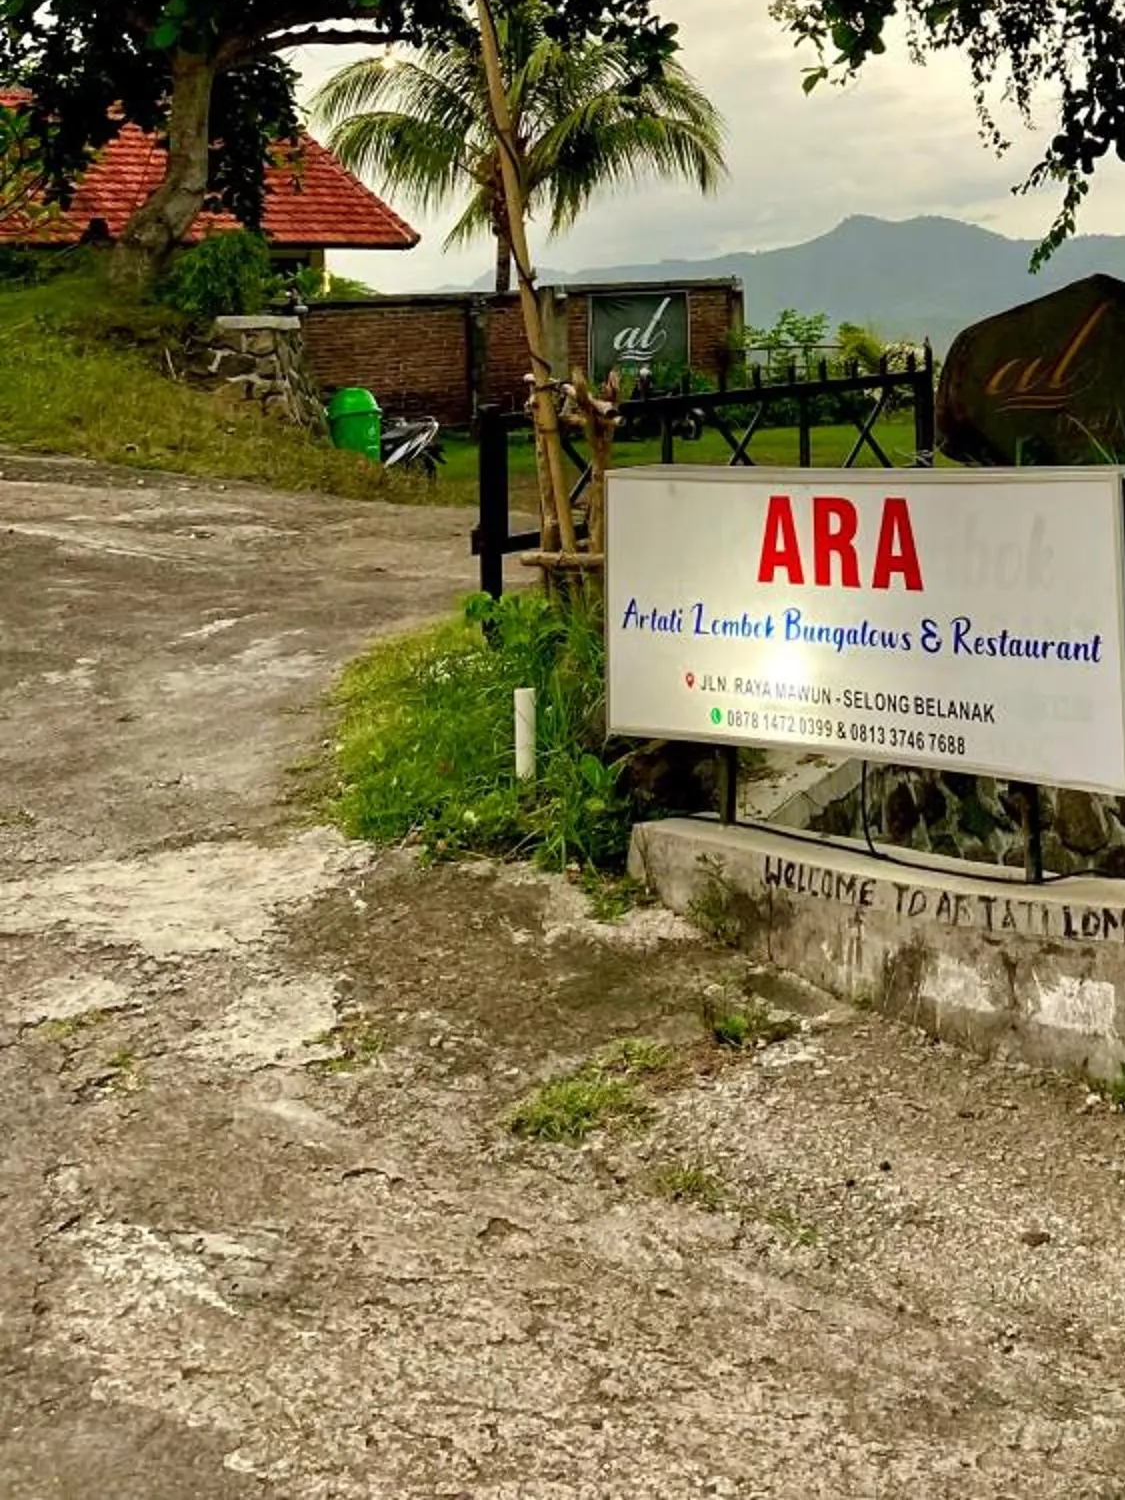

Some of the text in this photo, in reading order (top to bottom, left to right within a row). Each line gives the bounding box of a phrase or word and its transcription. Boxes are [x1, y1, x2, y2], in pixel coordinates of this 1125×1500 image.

[757, 495, 925, 592] ARA
[622, 597, 684, 634] Artati
[784, 606, 912, 653] Bungalows
[920, 618, 943, 654] &
[950, 615, 1105, 664] Restaurant
[734, 676, 772, 699] RAYA
[775, 680, 831, 706] MAWUN
[914, 696, 996, 725] BELANAK
[727, 708, 967, 756] 0878 1472 0399 & 0813 3746 7688
[892, 880, 928, 918] TO
